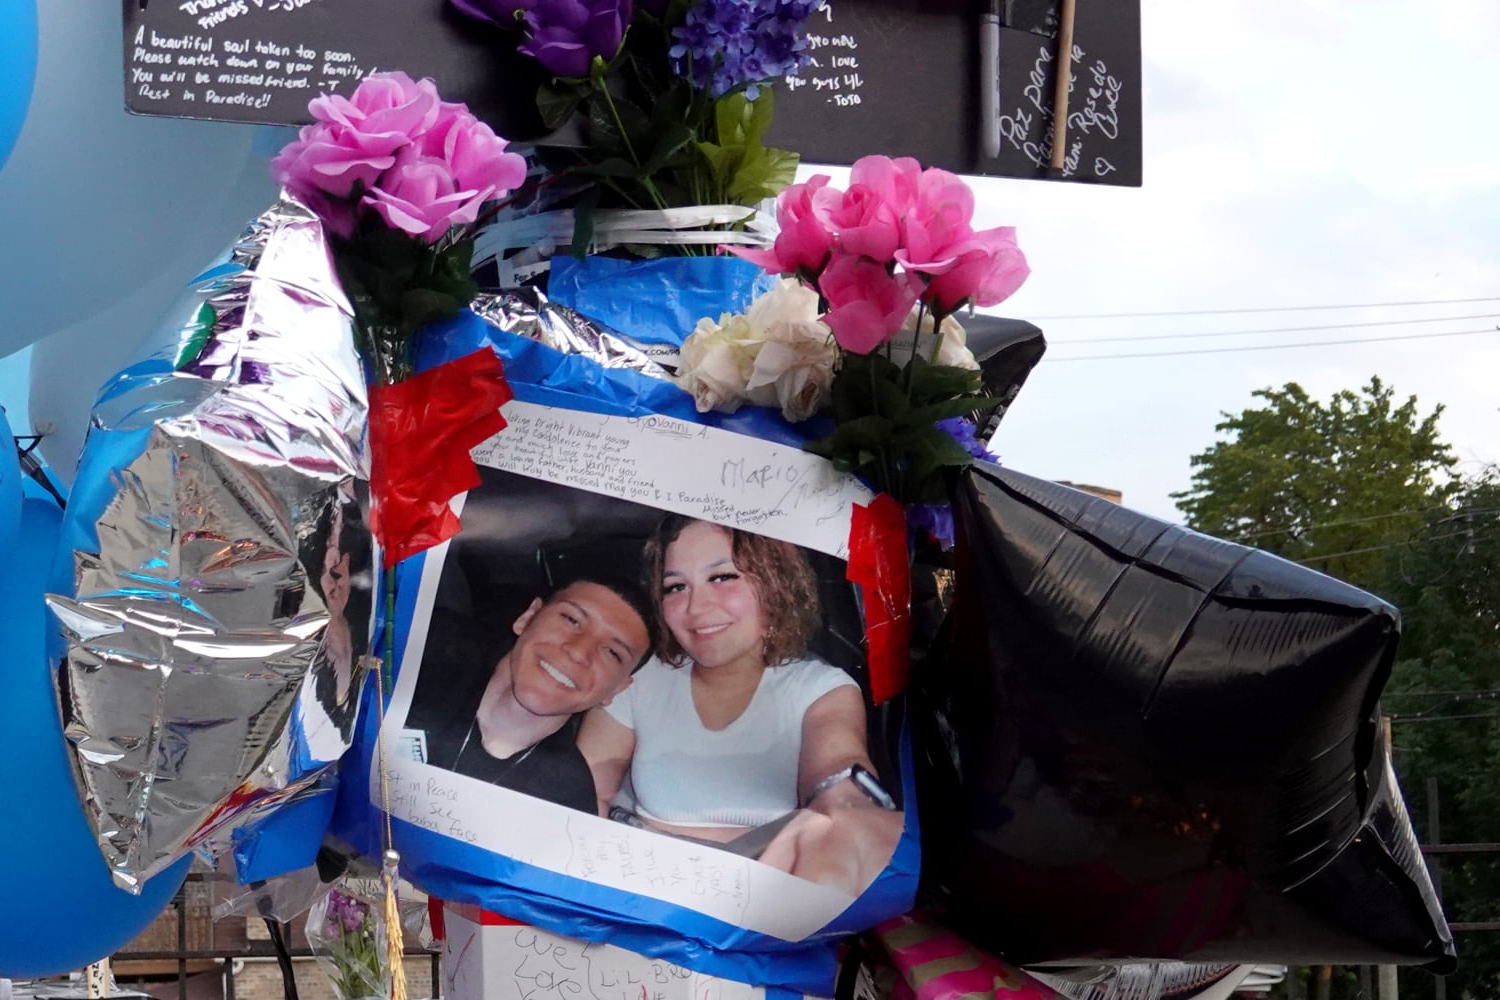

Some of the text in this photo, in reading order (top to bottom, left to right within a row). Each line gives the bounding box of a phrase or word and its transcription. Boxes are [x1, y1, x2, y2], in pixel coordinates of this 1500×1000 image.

[135, 25, 356, 62] A beautiful soul taken too soon.
[133, 49, 172, 64] Please
[178, 54, 219, 67] watch
[226, 57, 258, 68] down
[265, 59, 280, 70] on
[286, 62, 313, 73] your
[132, 68, 153, 83] You
[160, 70, 185, 83] will
[195, 72, 211, 84] be
[218, 72, 263, 84] missed
[139, 84, 171, 99] Rest
[183, 90, 195, 102] in
[1000, 108, 1032, 150] Paz
